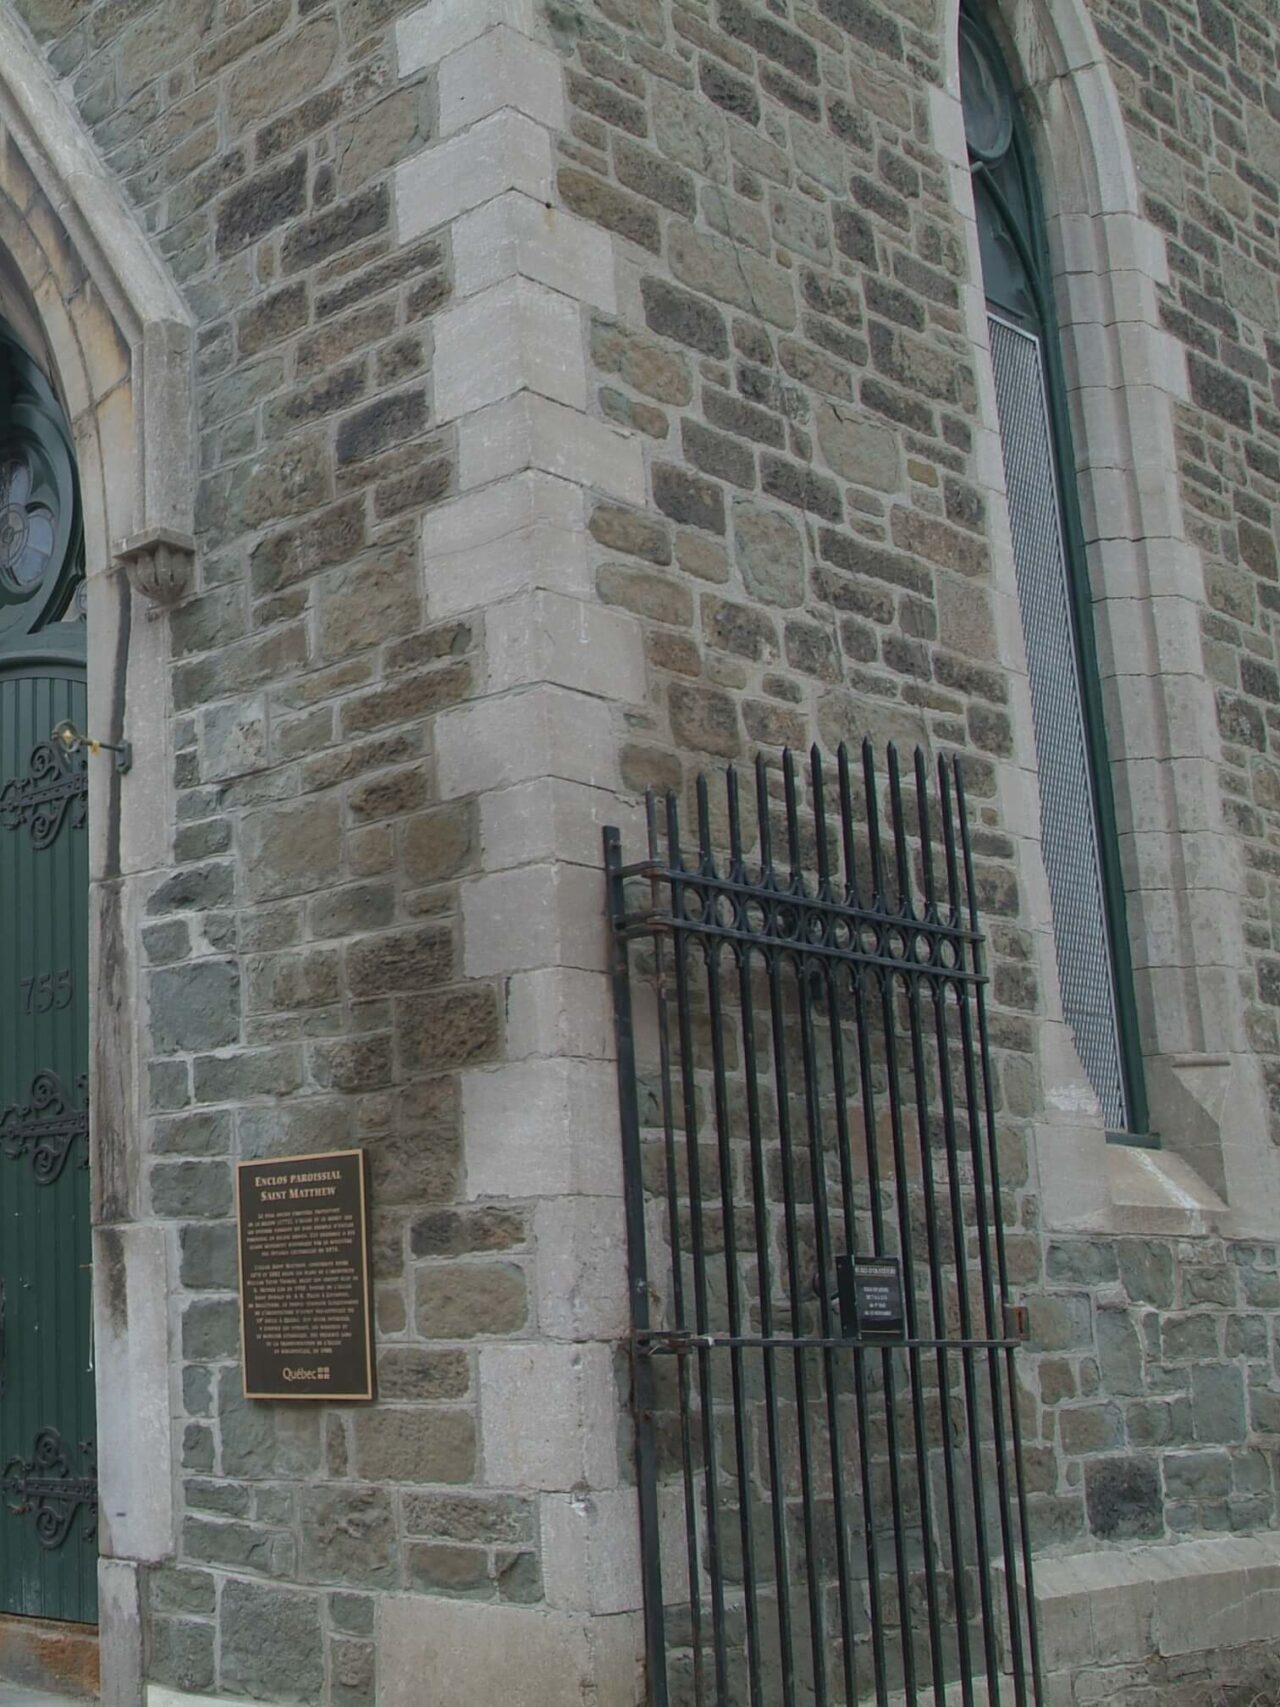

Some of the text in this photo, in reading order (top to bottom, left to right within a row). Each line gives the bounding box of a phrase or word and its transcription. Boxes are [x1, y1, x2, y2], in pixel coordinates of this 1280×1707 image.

[19, 970, 73, 1015] 755
[255, 1170, 342, 1187] ENCLOS PAROISSIAL
[261, 1186, 337, 1201] SAINT MATTHEW
[282, 1367, 317, 1381] Québec
